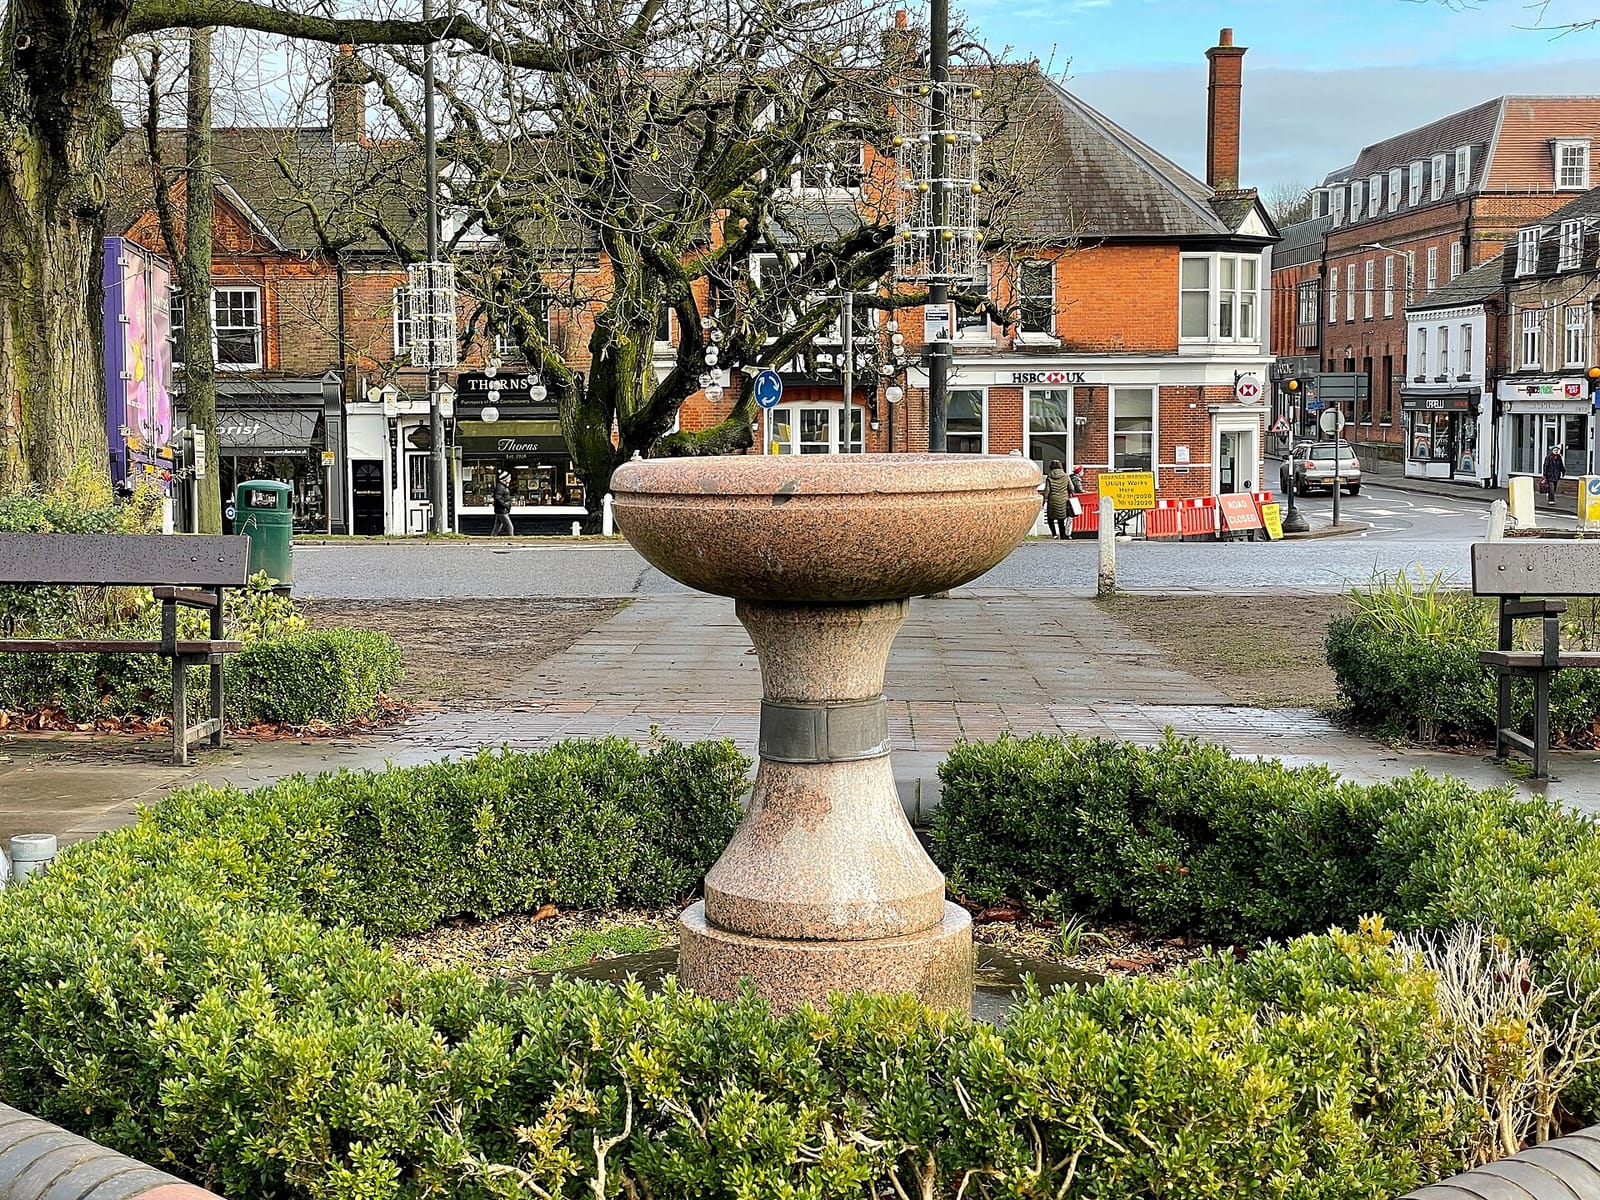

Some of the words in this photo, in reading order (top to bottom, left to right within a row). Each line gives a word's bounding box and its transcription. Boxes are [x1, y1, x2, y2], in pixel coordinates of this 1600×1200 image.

[1012, 372, 1046, 383] HSBC
[1066, 372, 1086, 382] UK
[468, 379, 528, 390] THRNS
[497, 438, 538, 452] Thorns
[1227, 500, 1248, 509] ROAD
[1228, 514, 1256, 524] CLOSED
